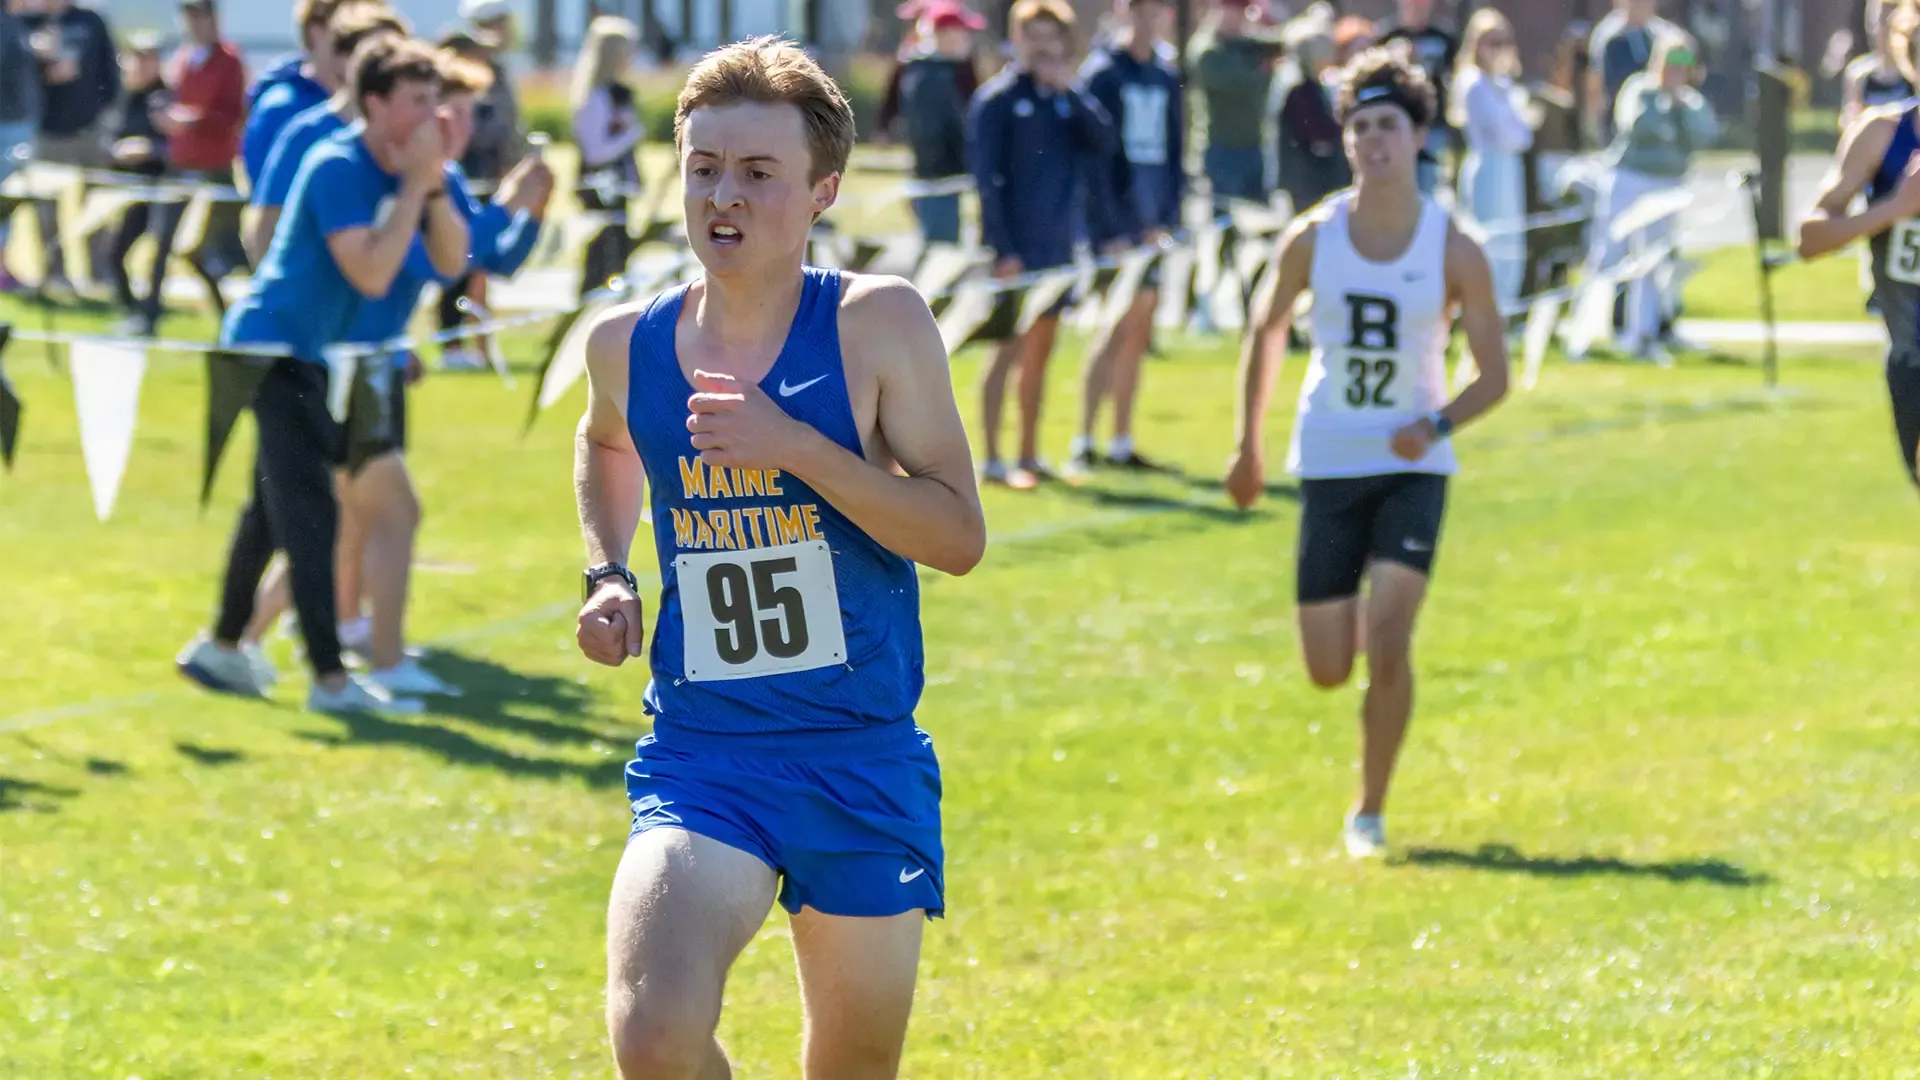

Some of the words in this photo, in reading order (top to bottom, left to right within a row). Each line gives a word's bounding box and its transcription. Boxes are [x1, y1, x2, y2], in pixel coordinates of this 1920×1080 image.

[1345, 293, 1398, 350] B
[1345, 357, 1396, 408] 32
[678, 456, 784, 499] MAINE
[670, 504, 825, 550] MARITIME
[706, 557, 809, 665] 95
